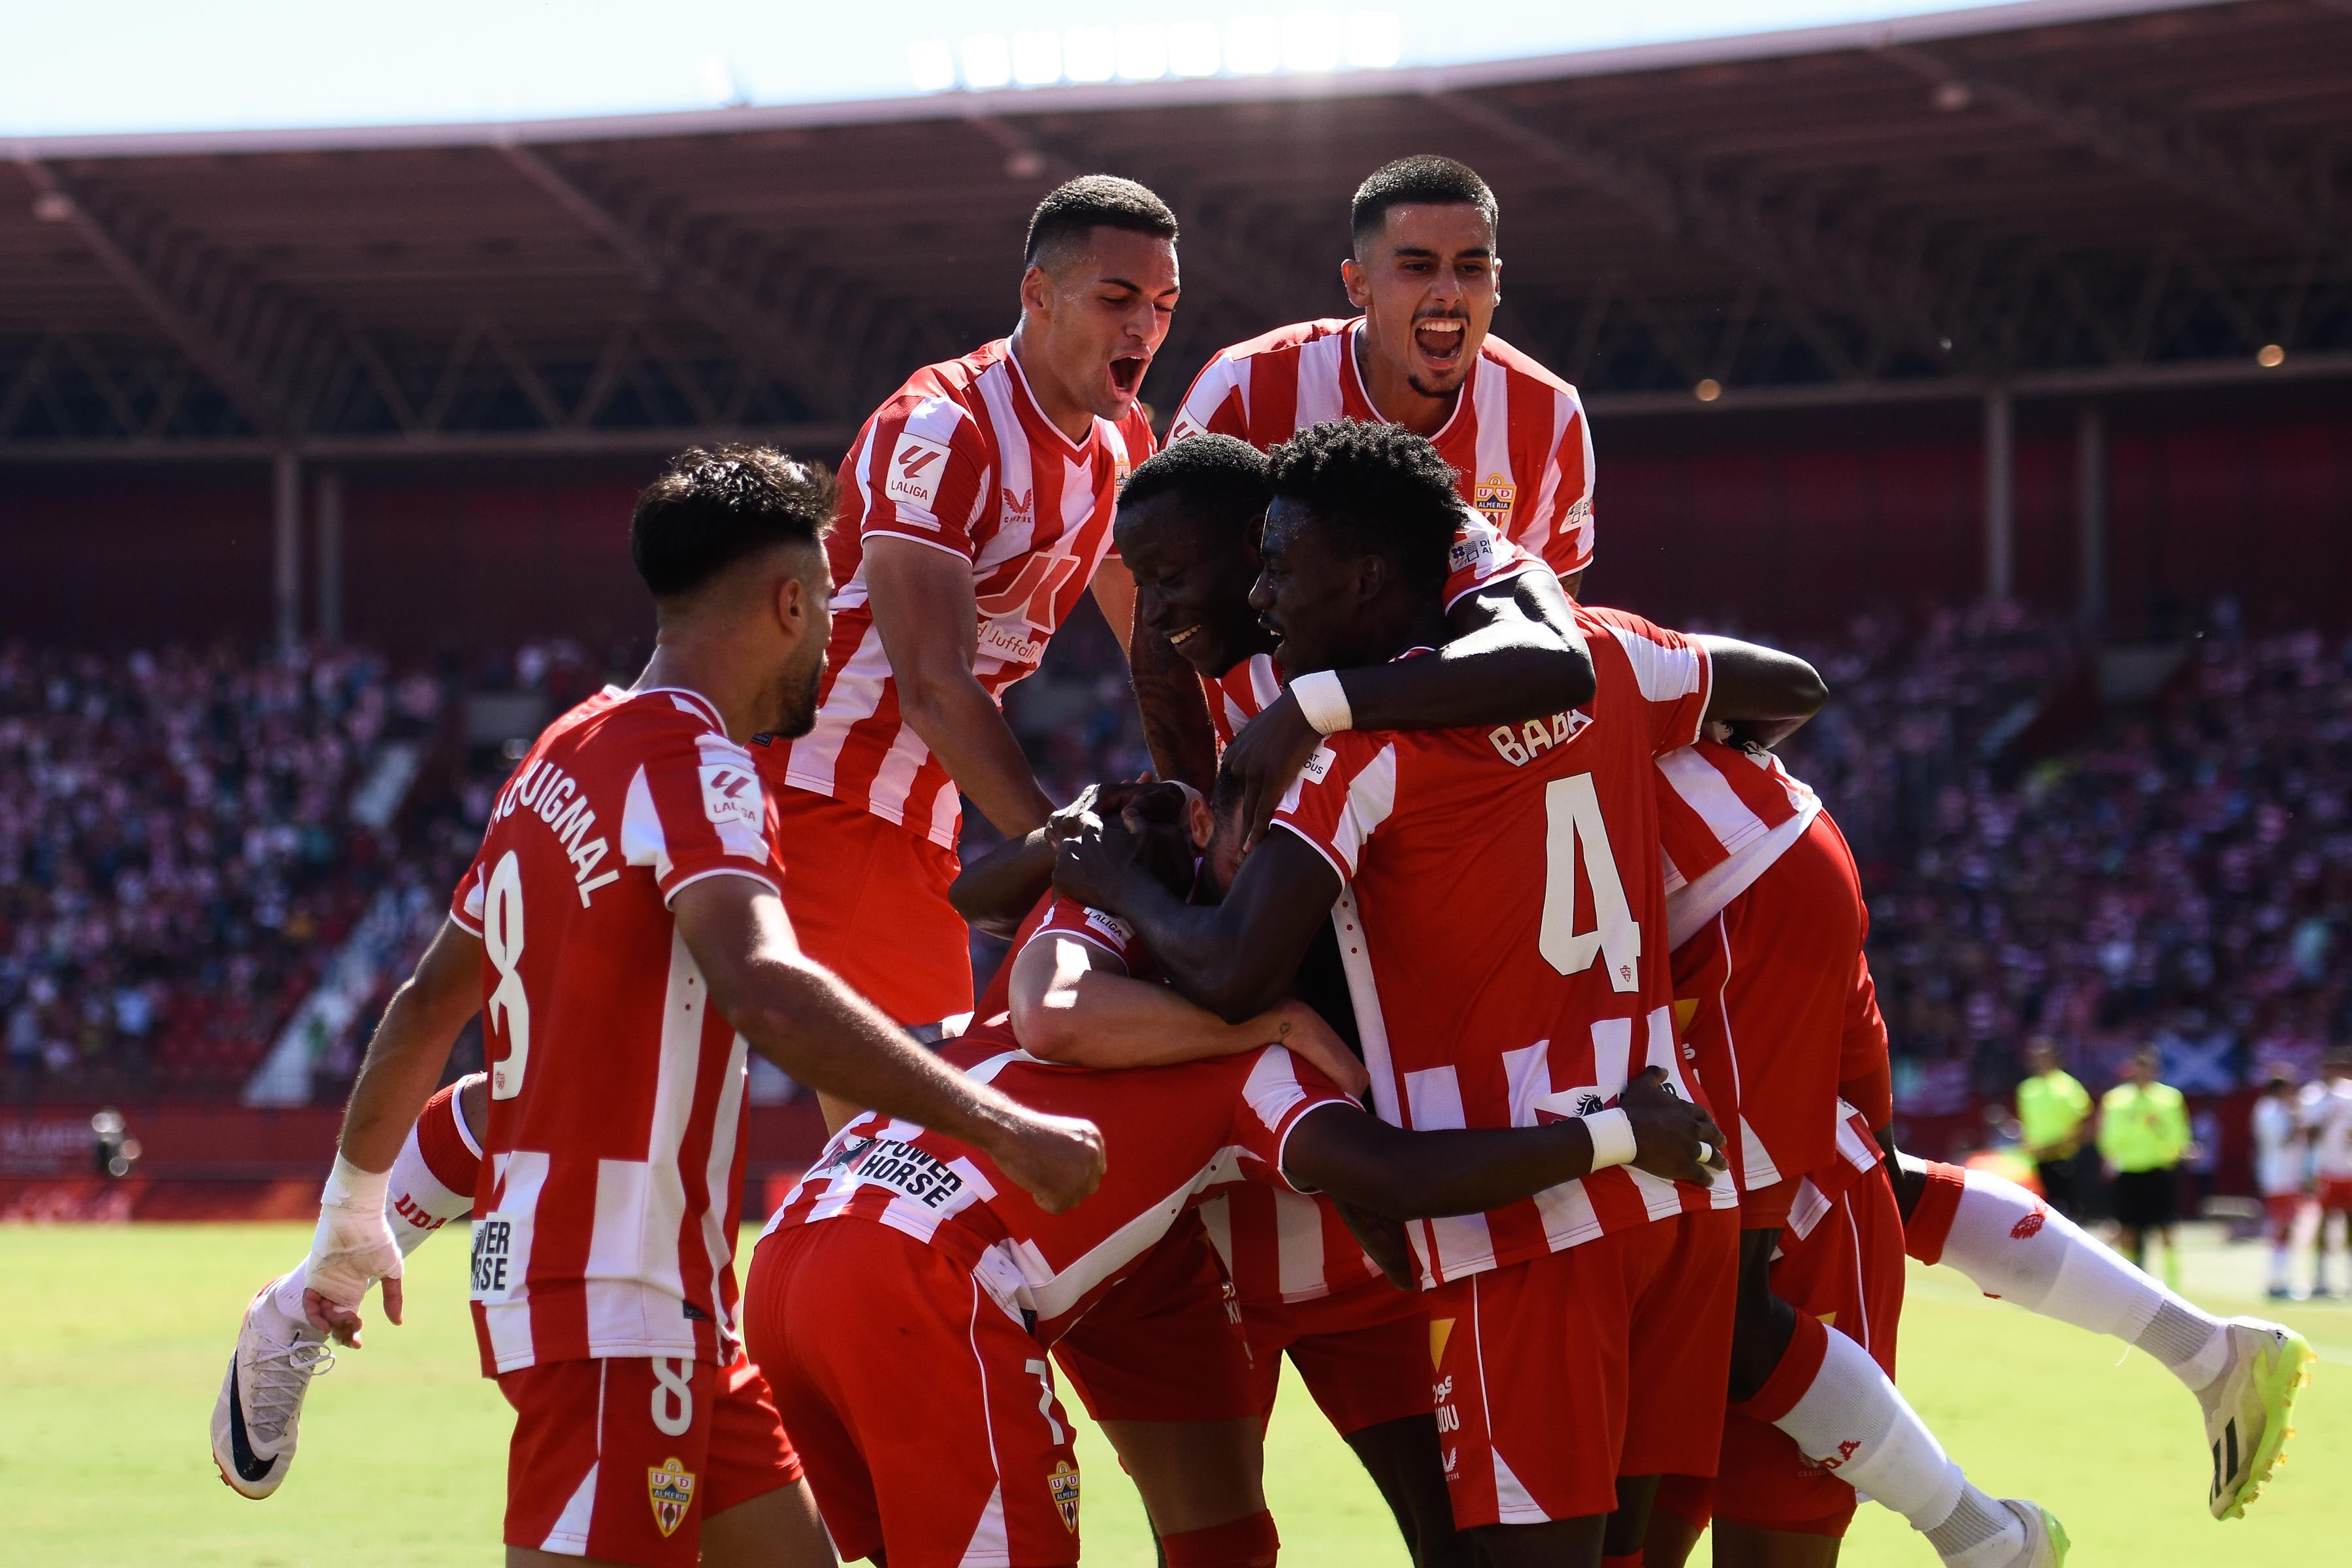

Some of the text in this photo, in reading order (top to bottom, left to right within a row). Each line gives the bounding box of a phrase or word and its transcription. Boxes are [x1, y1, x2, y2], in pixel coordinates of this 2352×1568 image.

[891, 480, 928, 500] LALIGA
[988, 630, 1037, 659] Juffali
[1303, 761, 1324, 774] OUS
[713, 802, 756, 821] LALGA
[506, 759, 620, 909] UIGMAL
[1539, 772, 1641, 992] 4
[484, 851, 529, 1100] 8
[857, 1154, 952, 1209] HORSE
[651, 1358, 693, 1437] 8
[1025, 1359, 1065, 1445] 7
[655, 1475, 689, 1488] U D
[1053, 1476, 1076, 1488] U D
[655, 1490, 687, 1501] ALMERIA
[1057, 1490, 1078, 1501] ALMERIA
